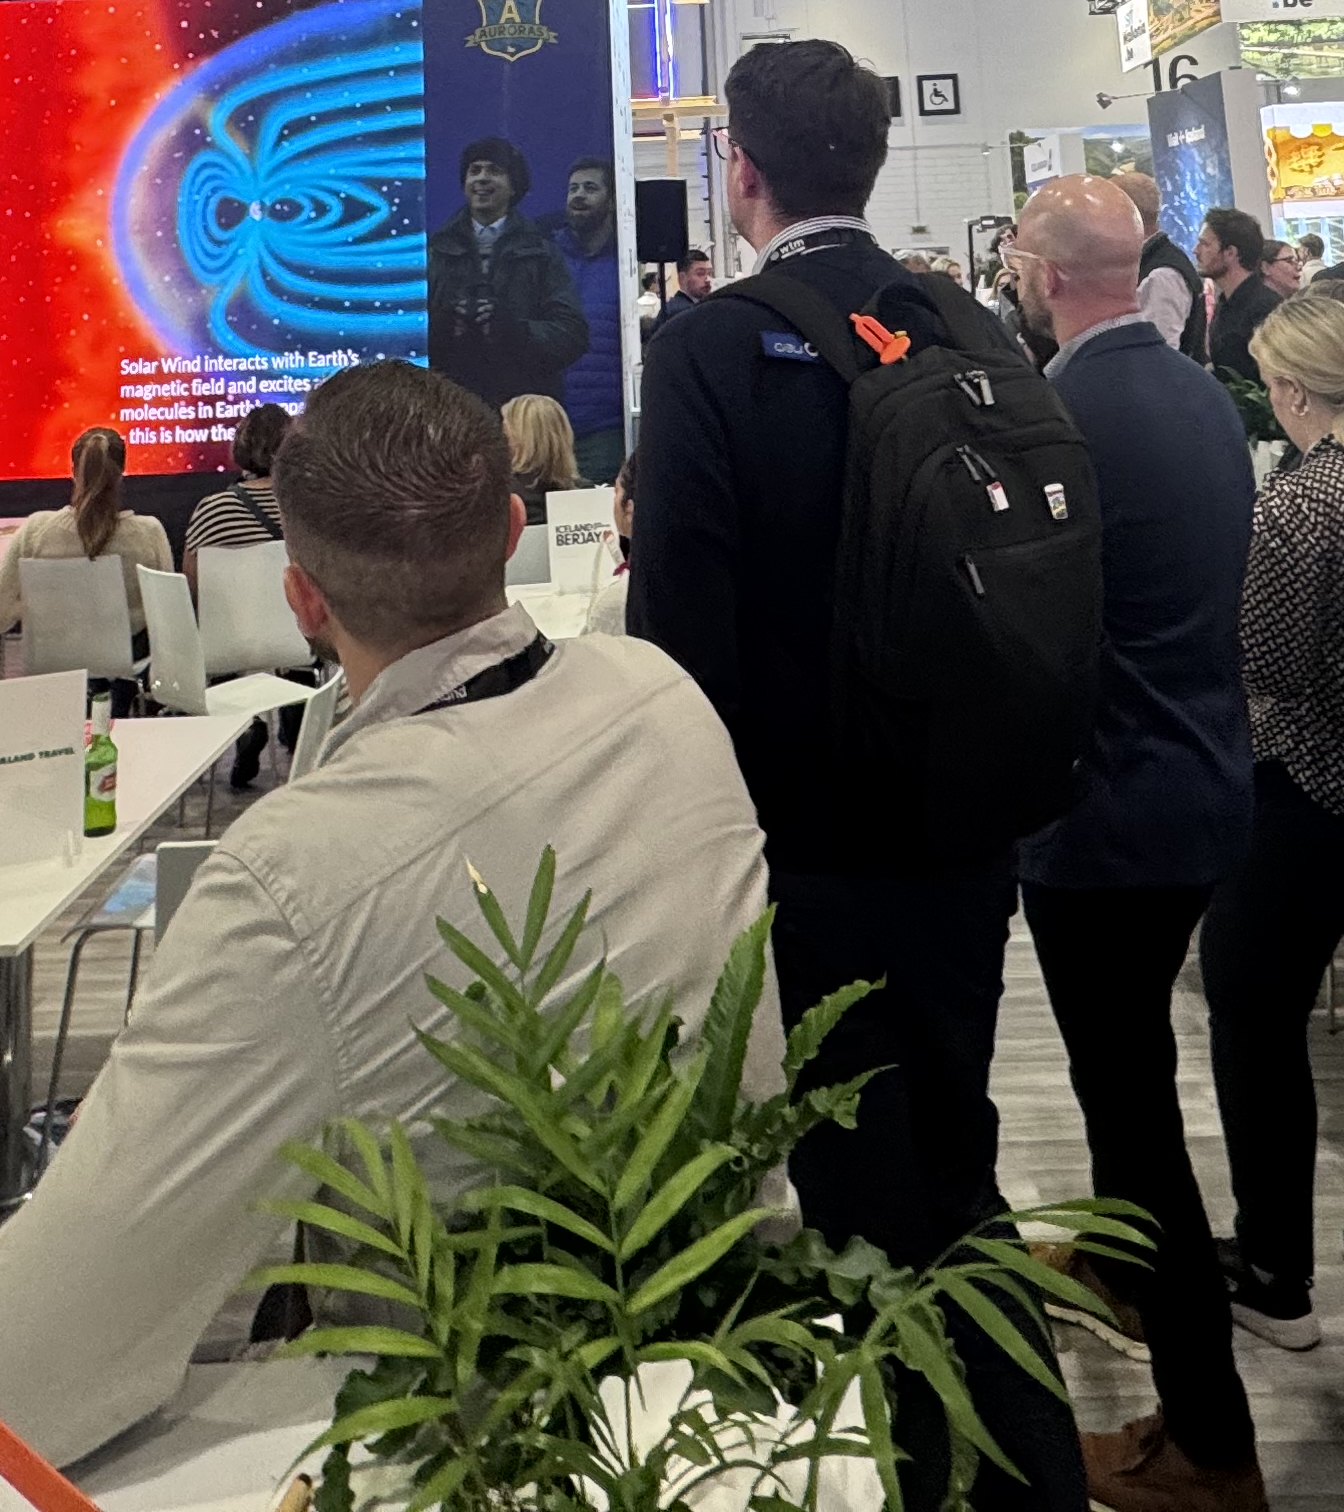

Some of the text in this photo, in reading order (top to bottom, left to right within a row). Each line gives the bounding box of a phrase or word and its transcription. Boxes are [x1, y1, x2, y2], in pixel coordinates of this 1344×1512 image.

[498, 0, 522, 24] A
[478, 26, 545, 40] AURORAS
[779, 238, 805, 255] wtm
[120, 349, 361, 376] Solar Wind interacts with Earth's
[119, 378, 189, 400] magnetic
[191, 377, 225, 396] field
[227, 376, 257, 394] and
[258, 374, 311, 392] excites
[119, 402, 196, 422] molecules
[197, 400, 212, 419] in
[128, 425, 157, 445] this
[159, 425, 173, 443] is
[174, 424, 210, 443] how
[556, 531, 602, 546] BERJAY
